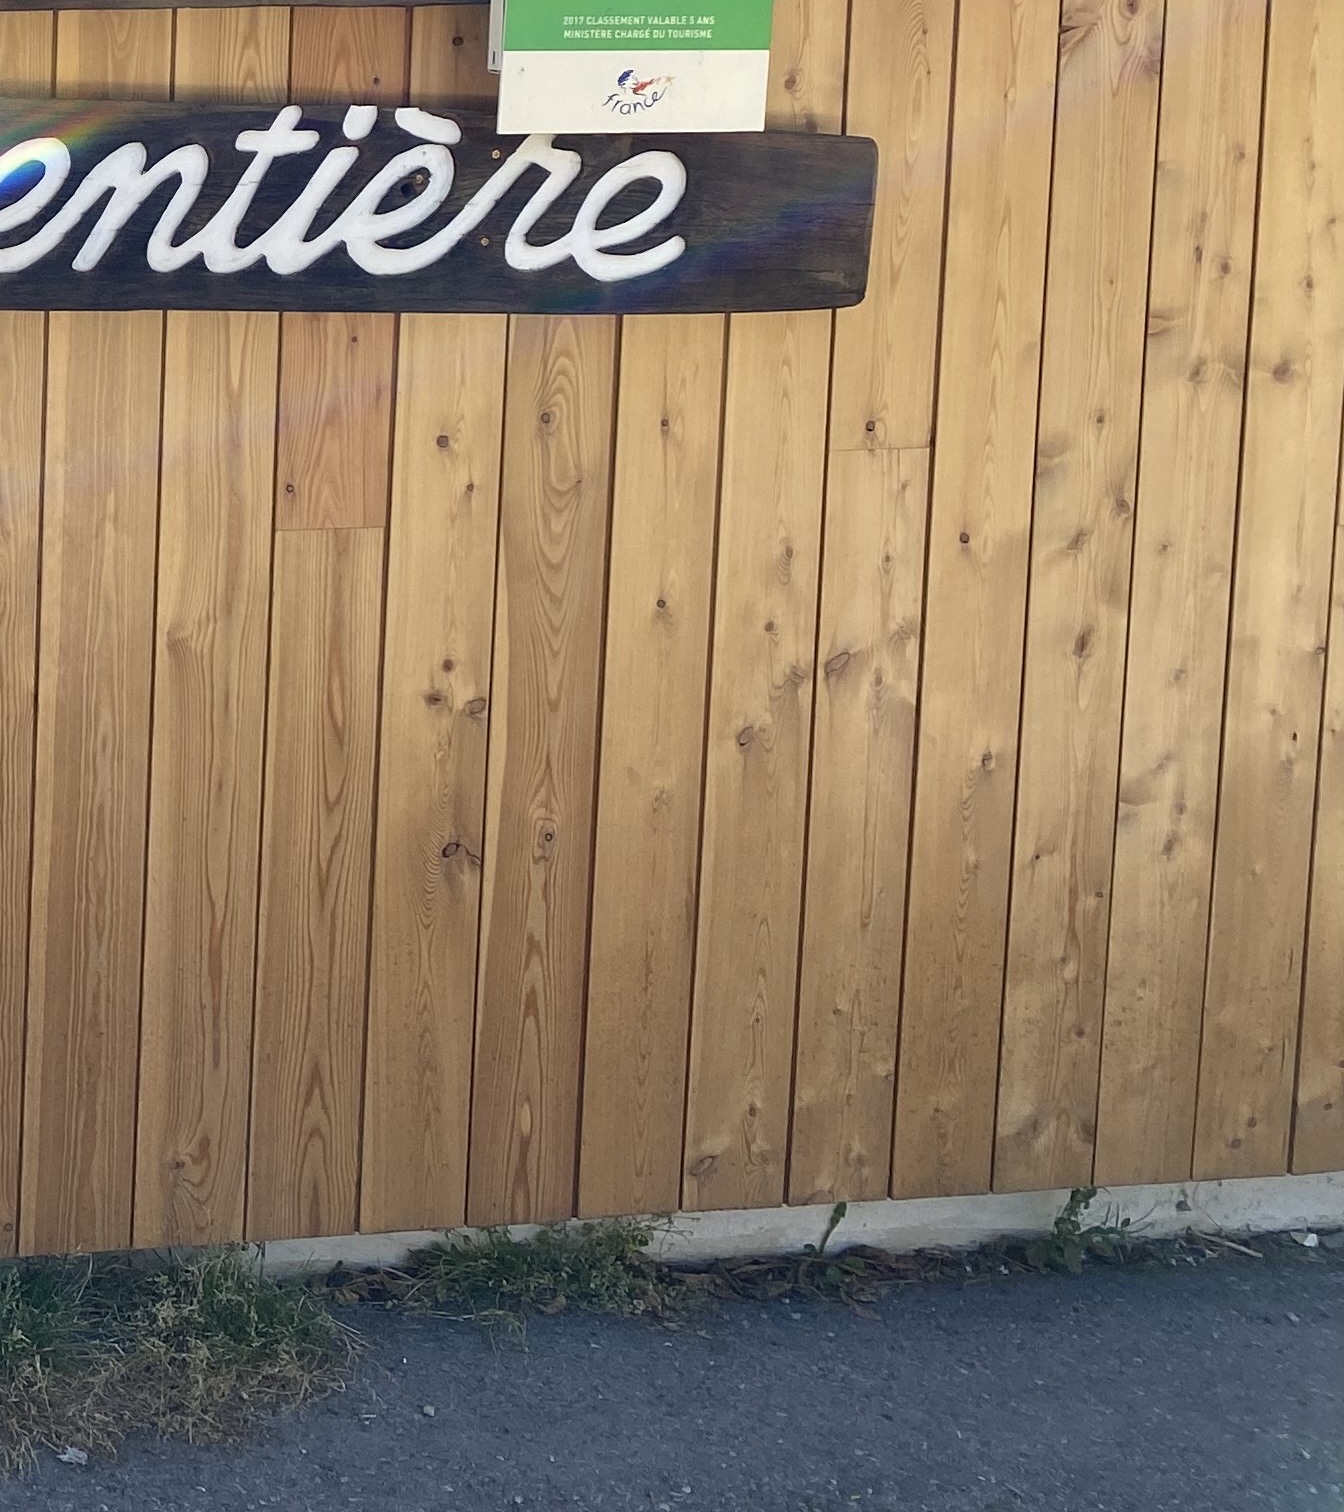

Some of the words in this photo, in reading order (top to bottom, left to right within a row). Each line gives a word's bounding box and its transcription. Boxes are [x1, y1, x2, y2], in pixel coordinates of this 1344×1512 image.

[563, 16, 584, 25] 2017
[586, 16, 645, 25] CLASSEMENT
[647, 16, 686, 25] VALABLE
[697, 16, 715, 25] ANS
[614, 27, 650, 38] CHARGÉ
[653, 29, 665, 38] DU
[667, 29, 712, 38] TOURISME
